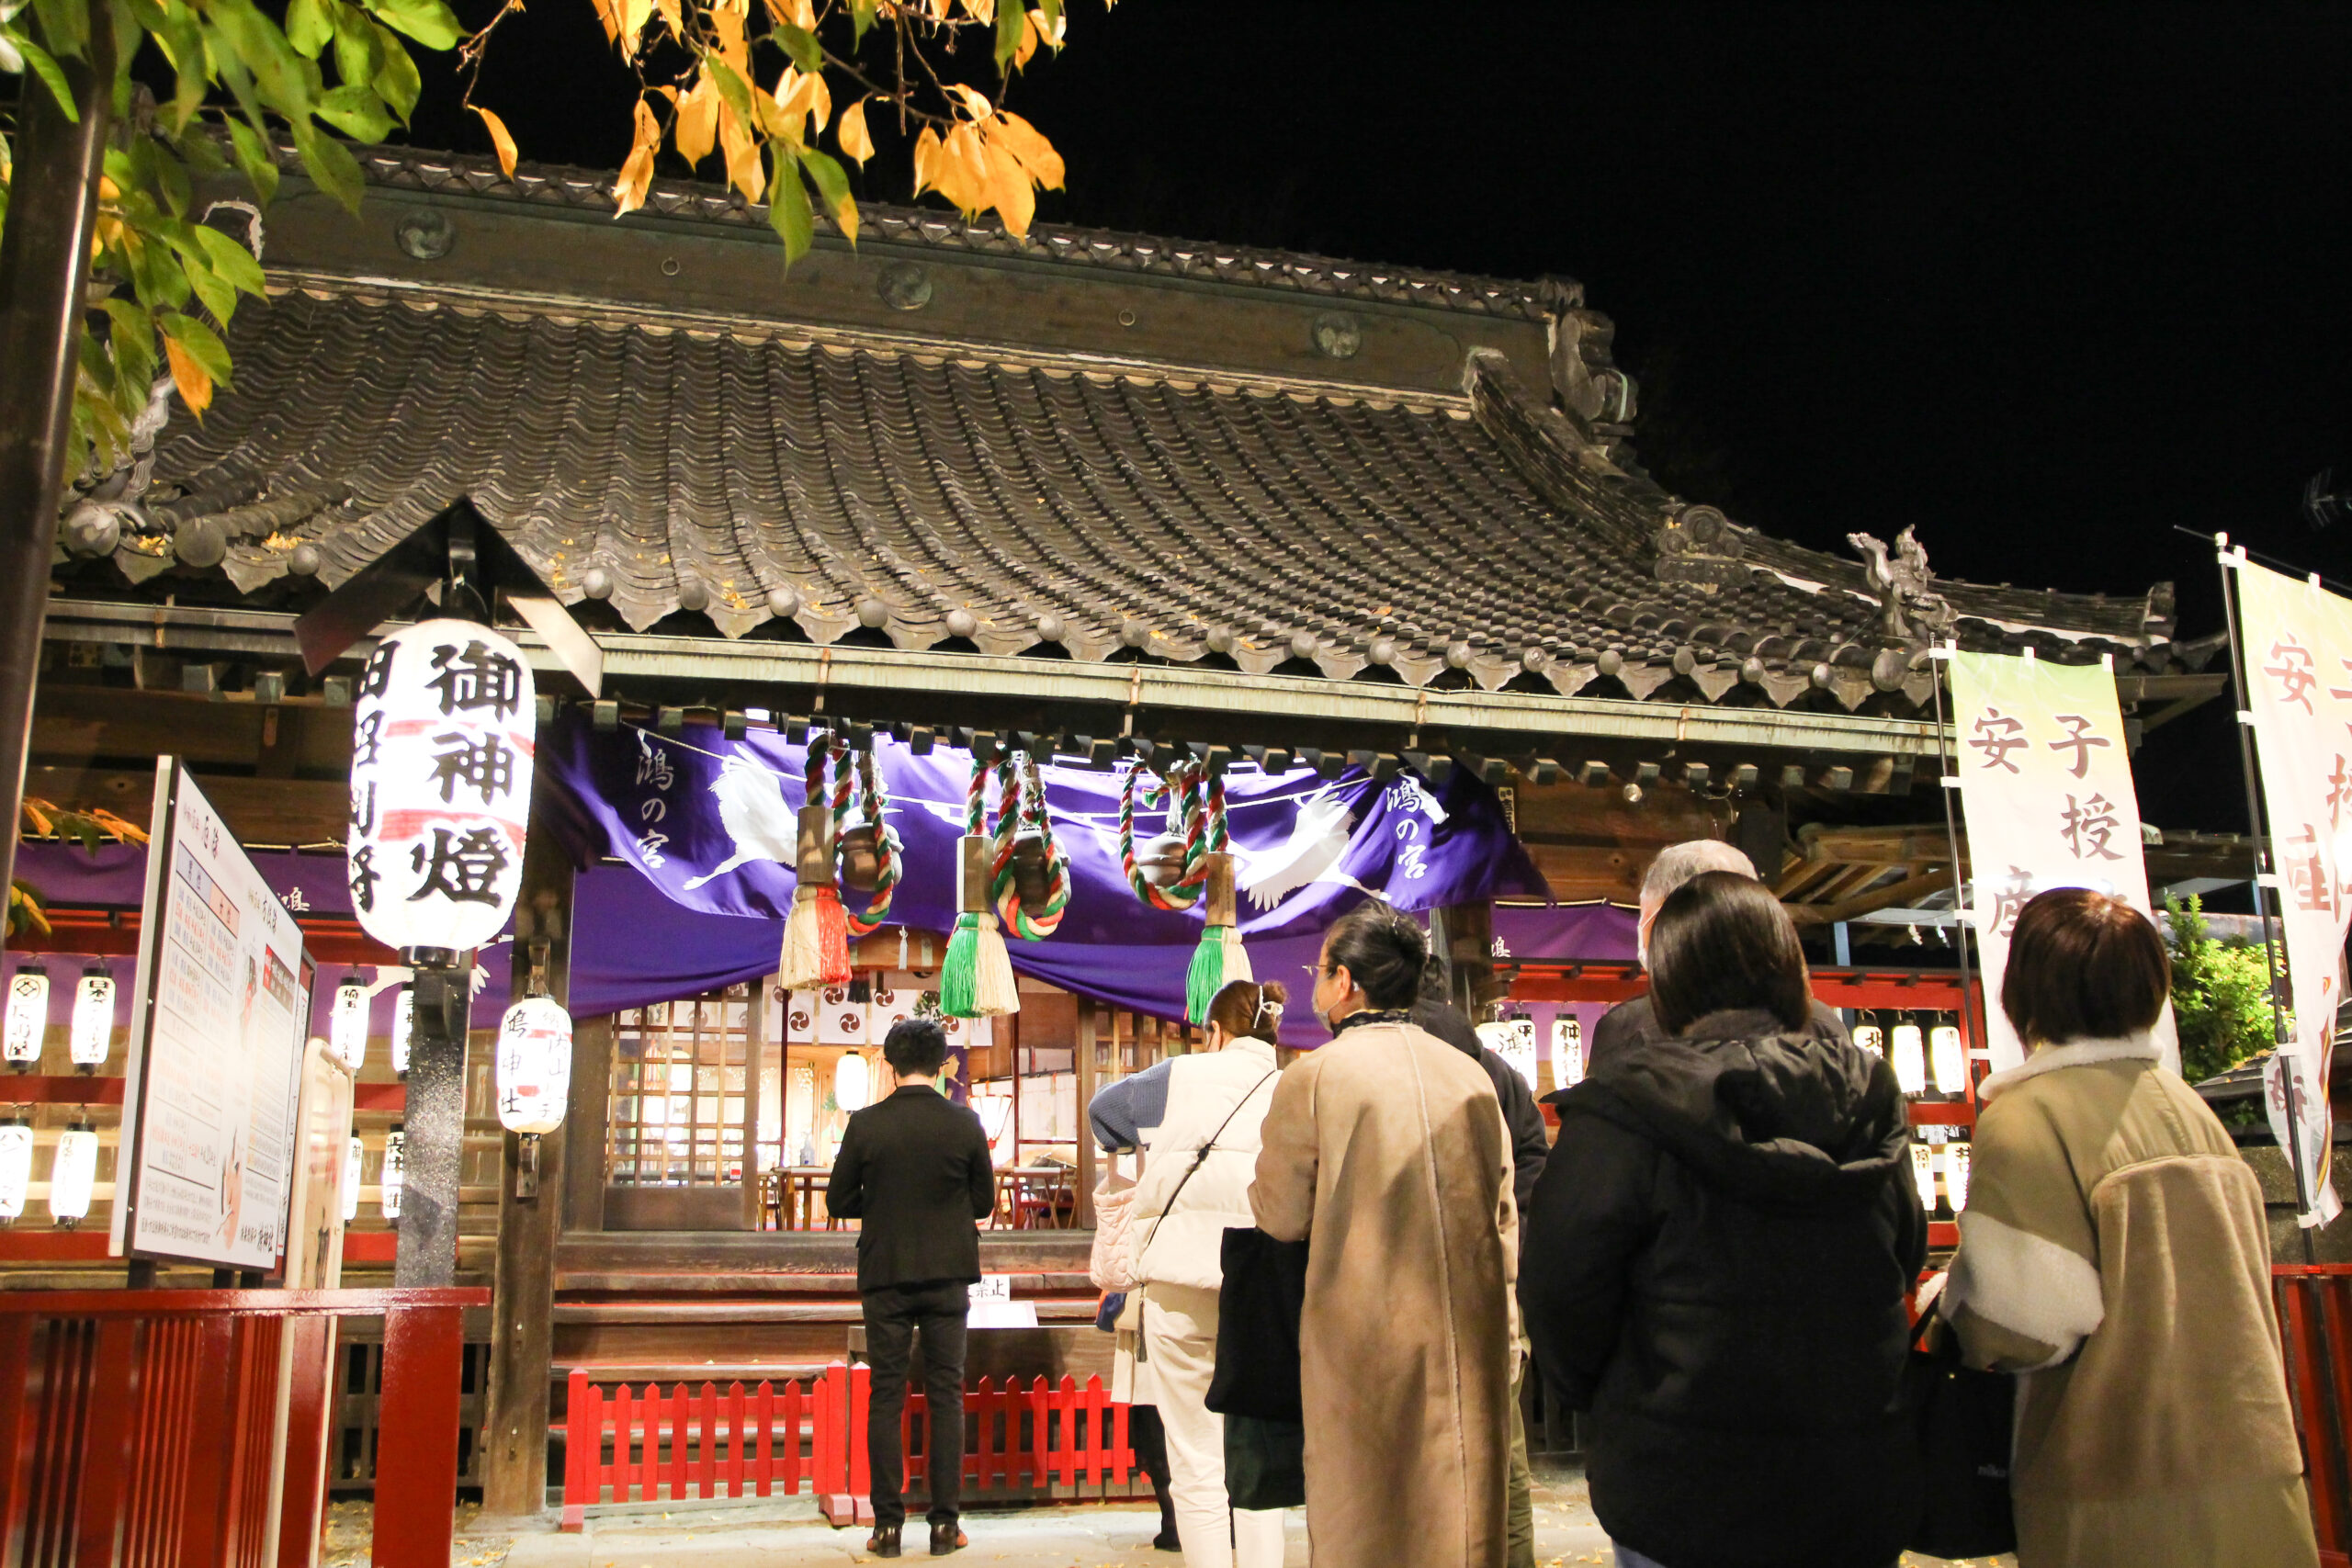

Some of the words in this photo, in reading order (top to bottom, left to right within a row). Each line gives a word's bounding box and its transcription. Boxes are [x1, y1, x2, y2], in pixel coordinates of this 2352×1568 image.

[406, 640, 524, 908] 御神燈
[636, 749, 673, 869] 鴻の宮
[1386, 781, 1428, 879] 鴻の宮
